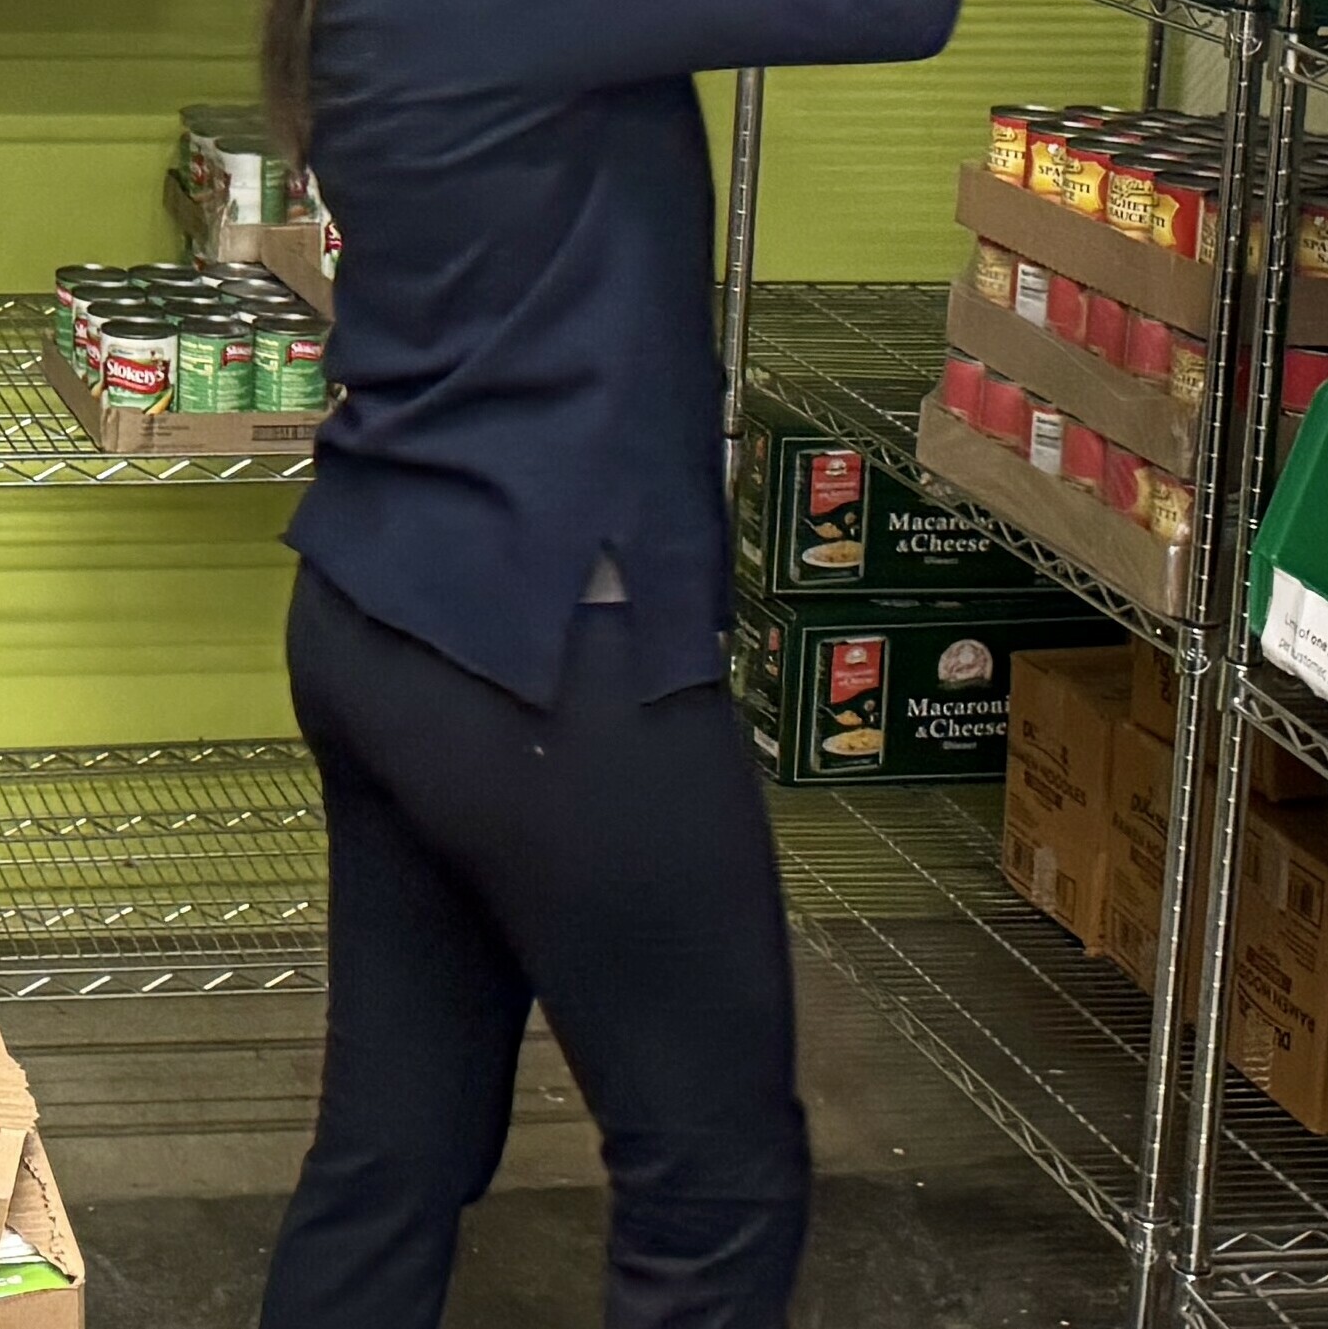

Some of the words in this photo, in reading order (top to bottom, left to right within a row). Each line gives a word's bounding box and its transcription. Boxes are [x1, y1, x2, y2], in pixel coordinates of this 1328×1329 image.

[105, 358, 166, 387] Stokely's
[896, 533, 991, 554] &Cheese
[907, 696, 1010, 717] Macaroni
[915, 720, 1007, 740] &Cheese
